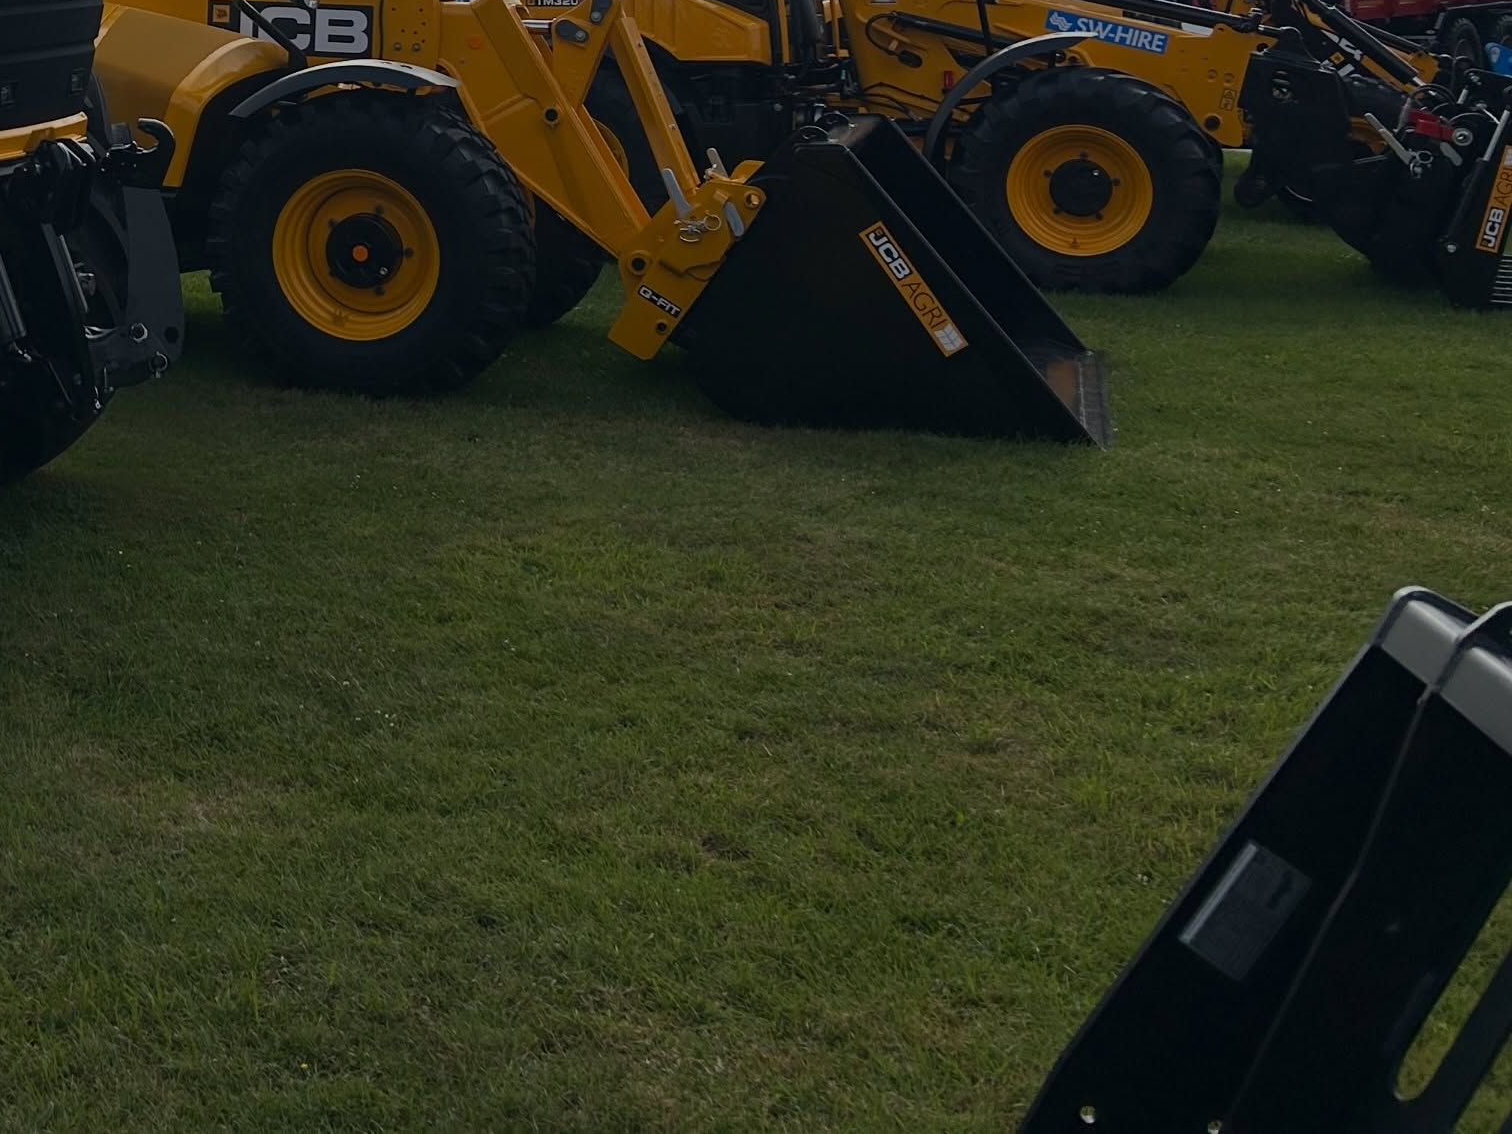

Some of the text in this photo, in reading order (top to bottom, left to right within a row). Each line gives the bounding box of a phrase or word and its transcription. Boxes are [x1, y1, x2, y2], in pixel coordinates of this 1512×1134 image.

[1076, 17, 1166, 52] SW-HIRE
[1483, 207, 1505, 248] JCB
[868, 231, 947, 329] JCB AGRI
